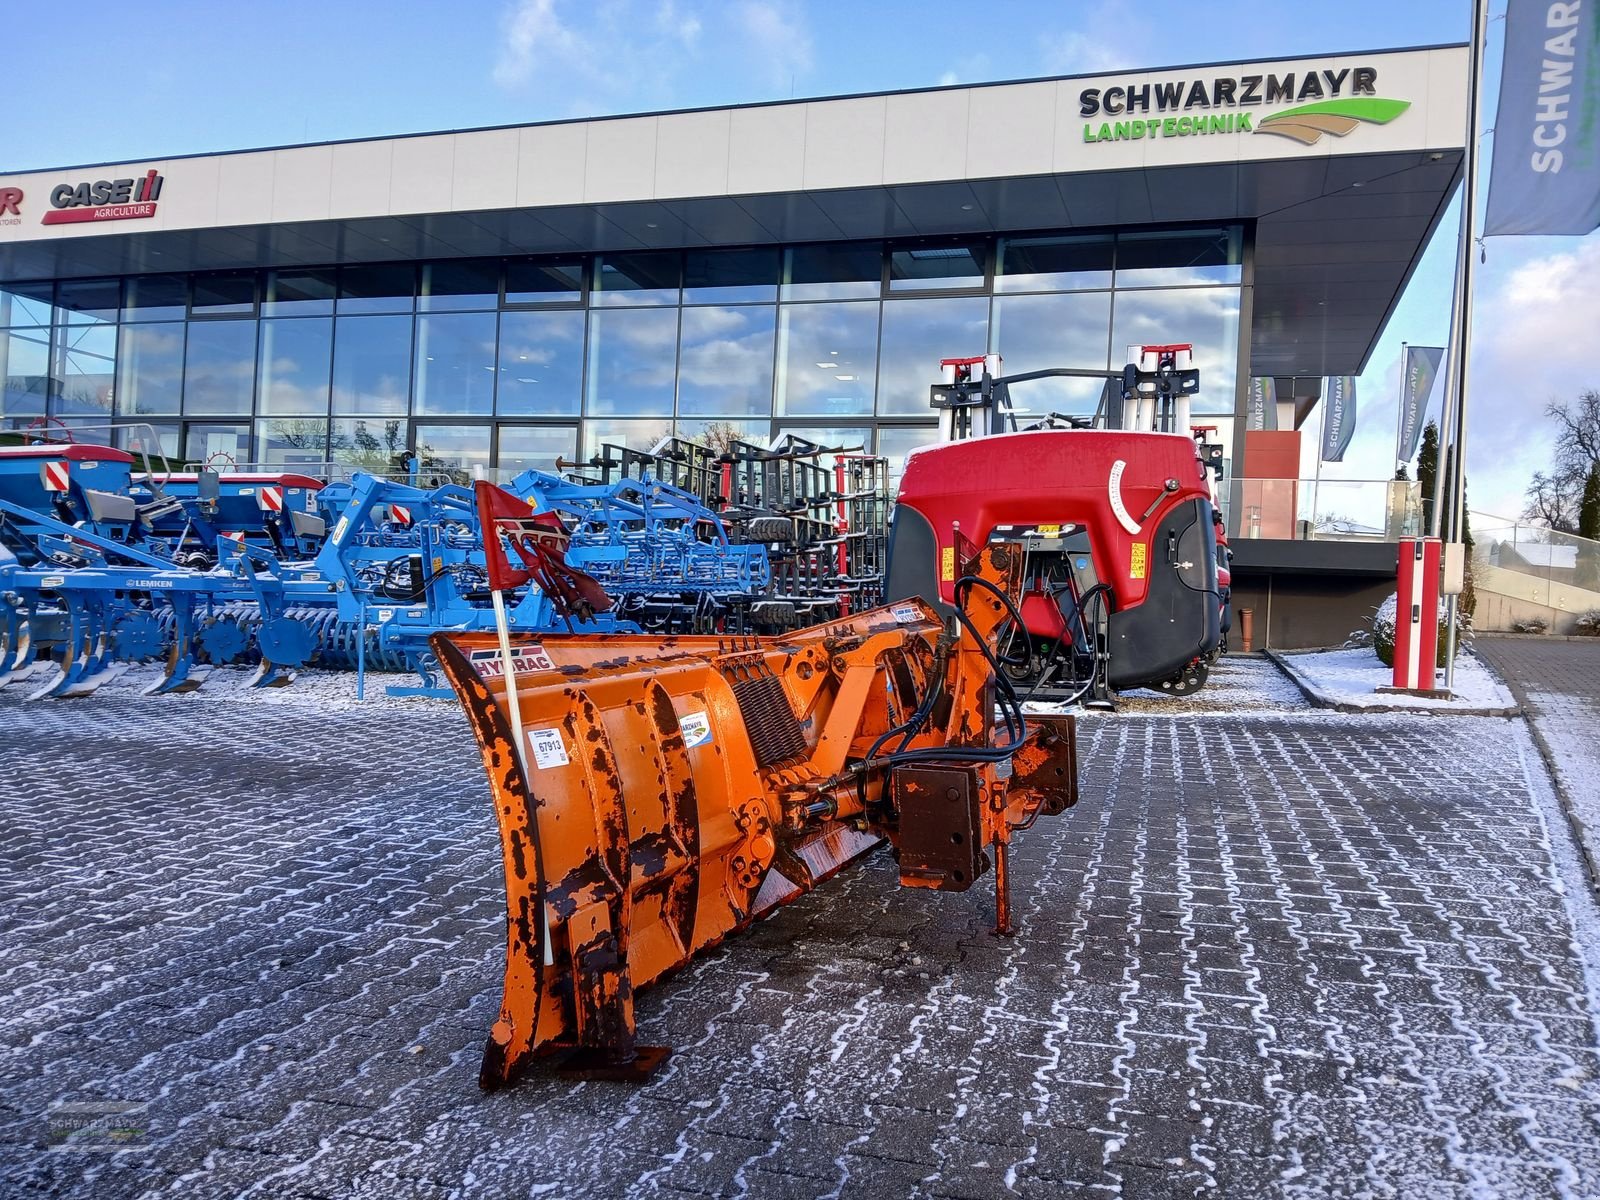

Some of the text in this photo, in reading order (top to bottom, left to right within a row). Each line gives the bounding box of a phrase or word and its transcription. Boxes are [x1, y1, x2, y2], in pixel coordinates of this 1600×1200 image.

[1080, 66, 1378, 117] SCHWARZMAYR
[1083, 112, 1253, 143] LANDTECHNIK
[50, 178, 134, 209] CASE
[93, 204, 151, 219] AGRICULTURE
[135, 580, 173, 588] LEMKEN
[473, 656, 550, 676] HYRAC
[538, 740, 562, 752] 67913
